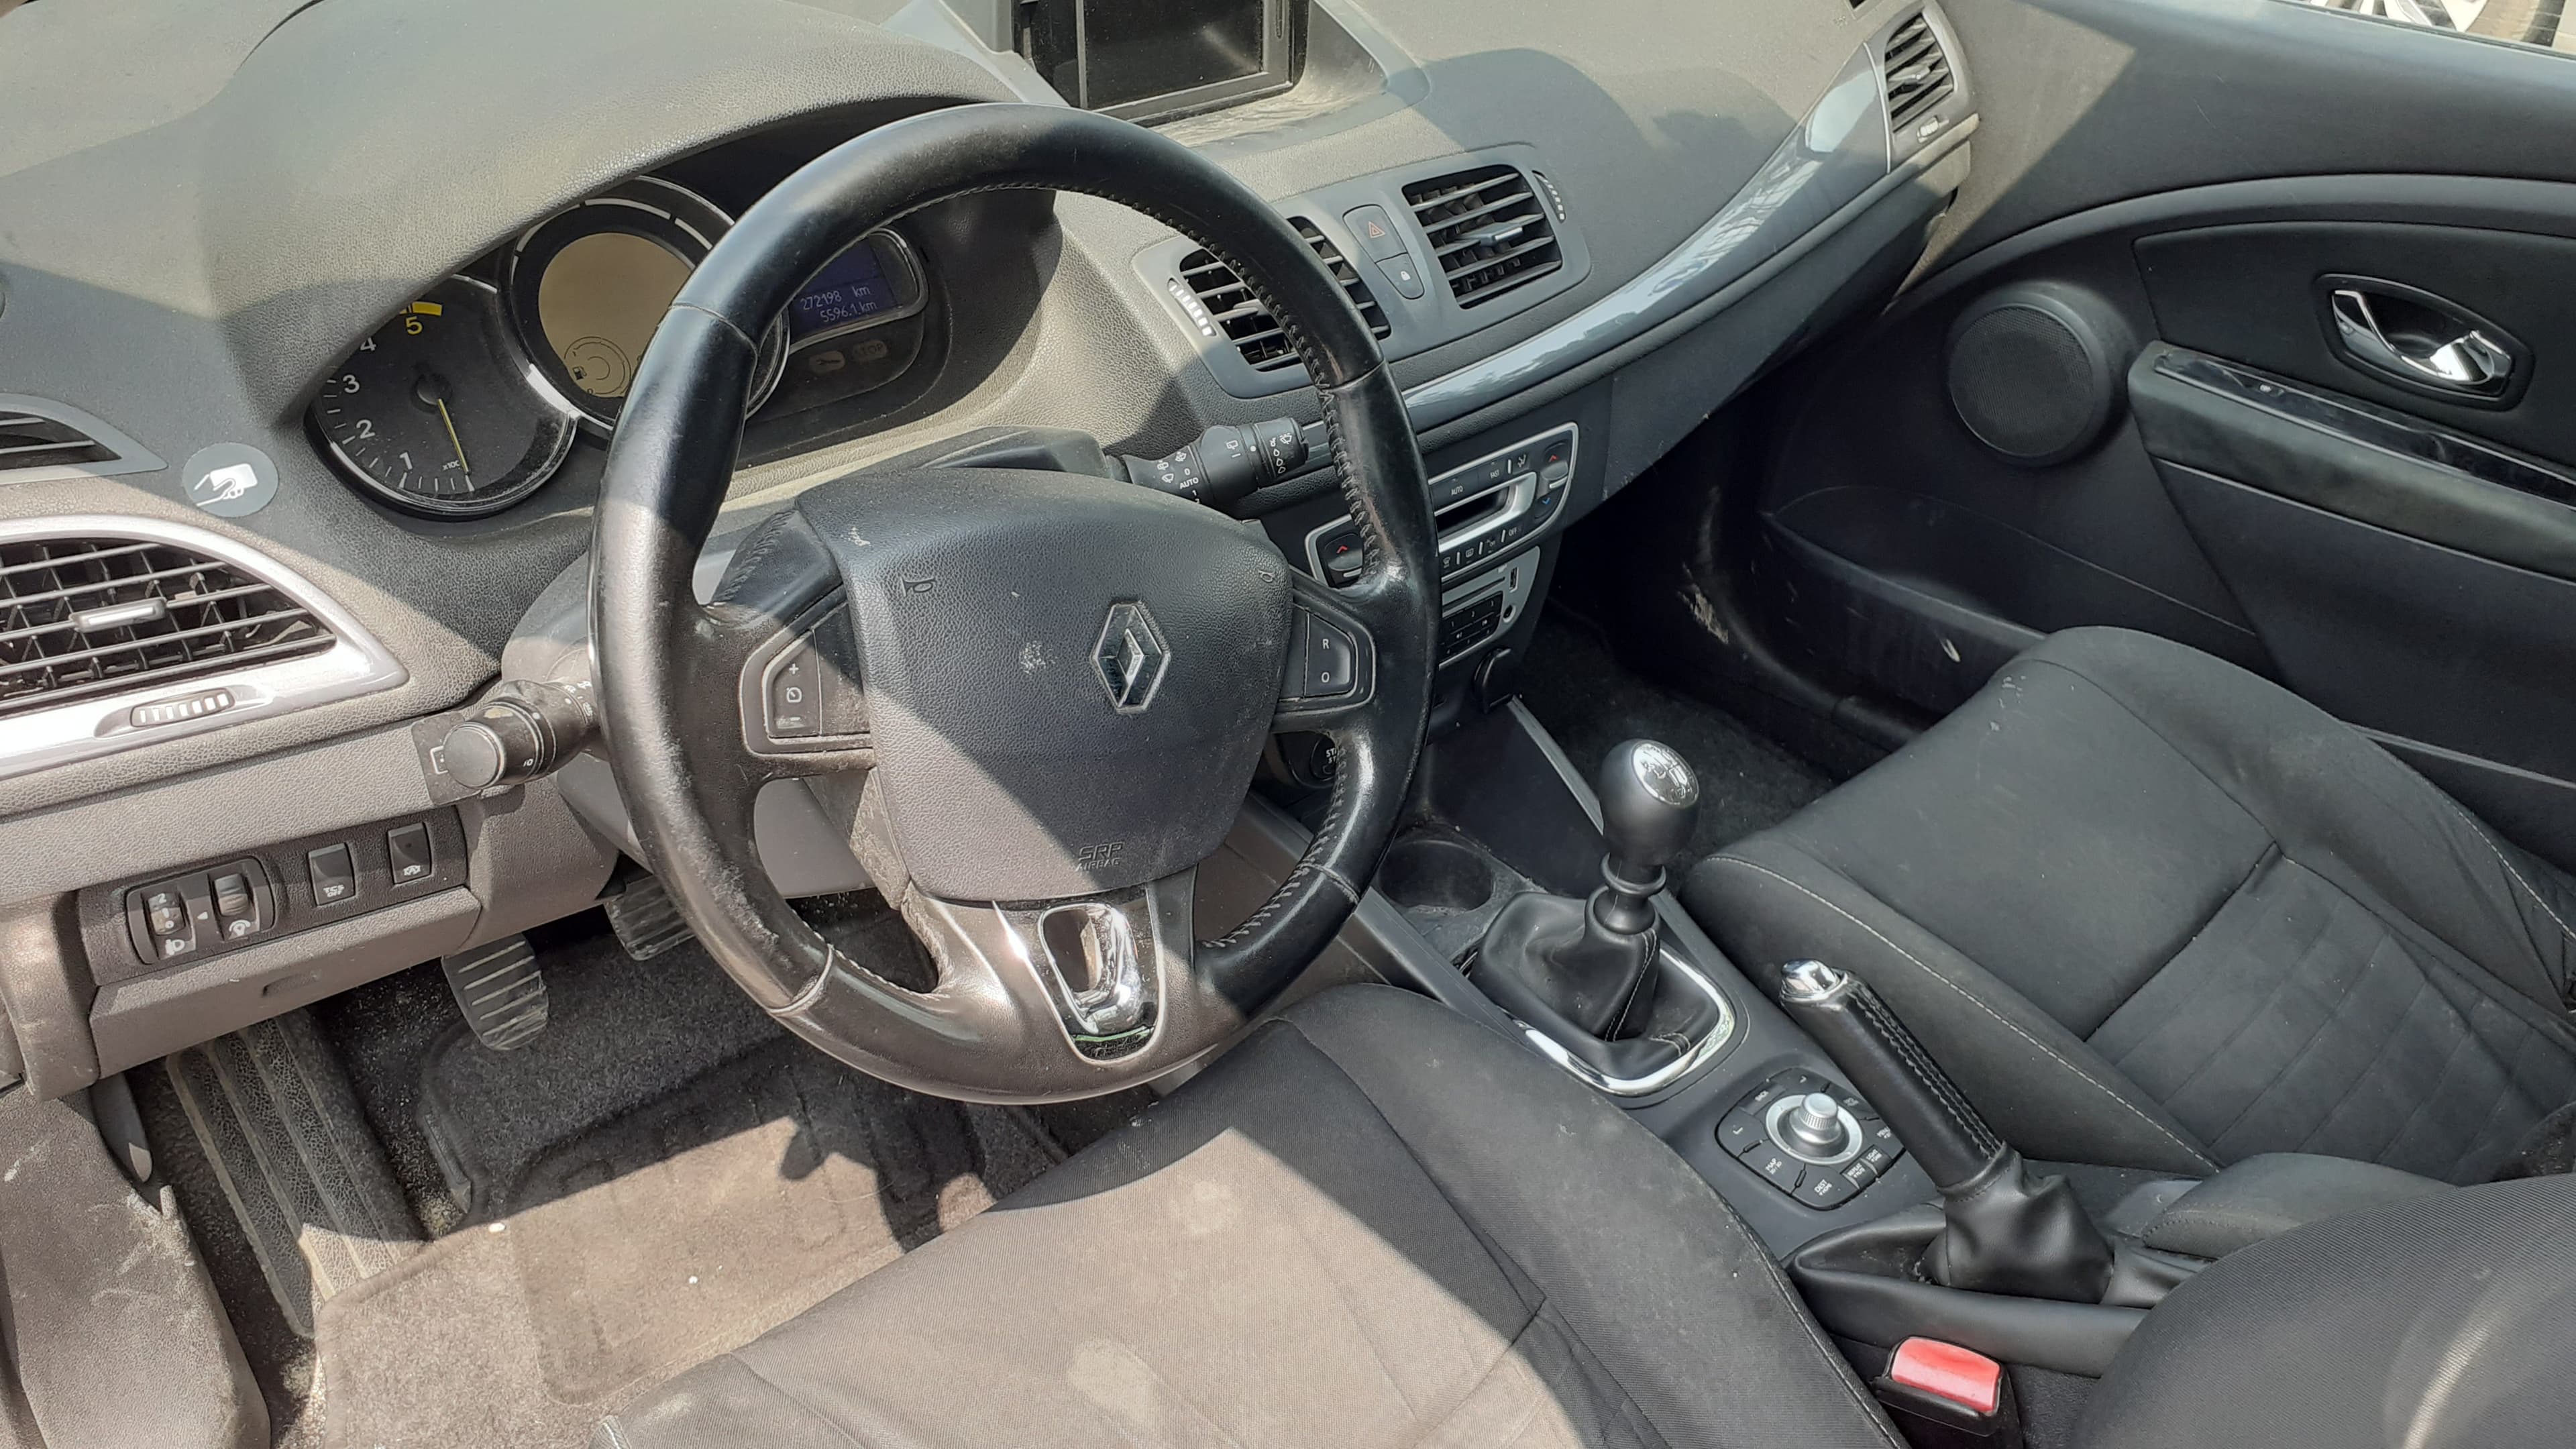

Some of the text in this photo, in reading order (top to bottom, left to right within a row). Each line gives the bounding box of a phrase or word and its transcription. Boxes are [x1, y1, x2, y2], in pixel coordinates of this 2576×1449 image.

[800, 286, 871, 310] 272198 km
[406, 316, 423, 335] 5
[360, 337, 376, 351] 4
[343, 374, 360, 394] 3
[356, 419, 376, 439] 2
[399, 451, 413, 470] 1
[1490, 469, 1499, 479] FAST
[1179, 477, 1199, 490] AUTO
[1451, 485, 1464, 496] AUTO
[1322, 639, 1330, 649] R
[1078, 841, 1125, 861] SRP
[1075, 857, 1122, 872] AIRBAG
[158, 893, 167, 904] 2
[1765, 1158, 1776, 1171] MAP
[1814, 1179, 1827, 1193] DEST
